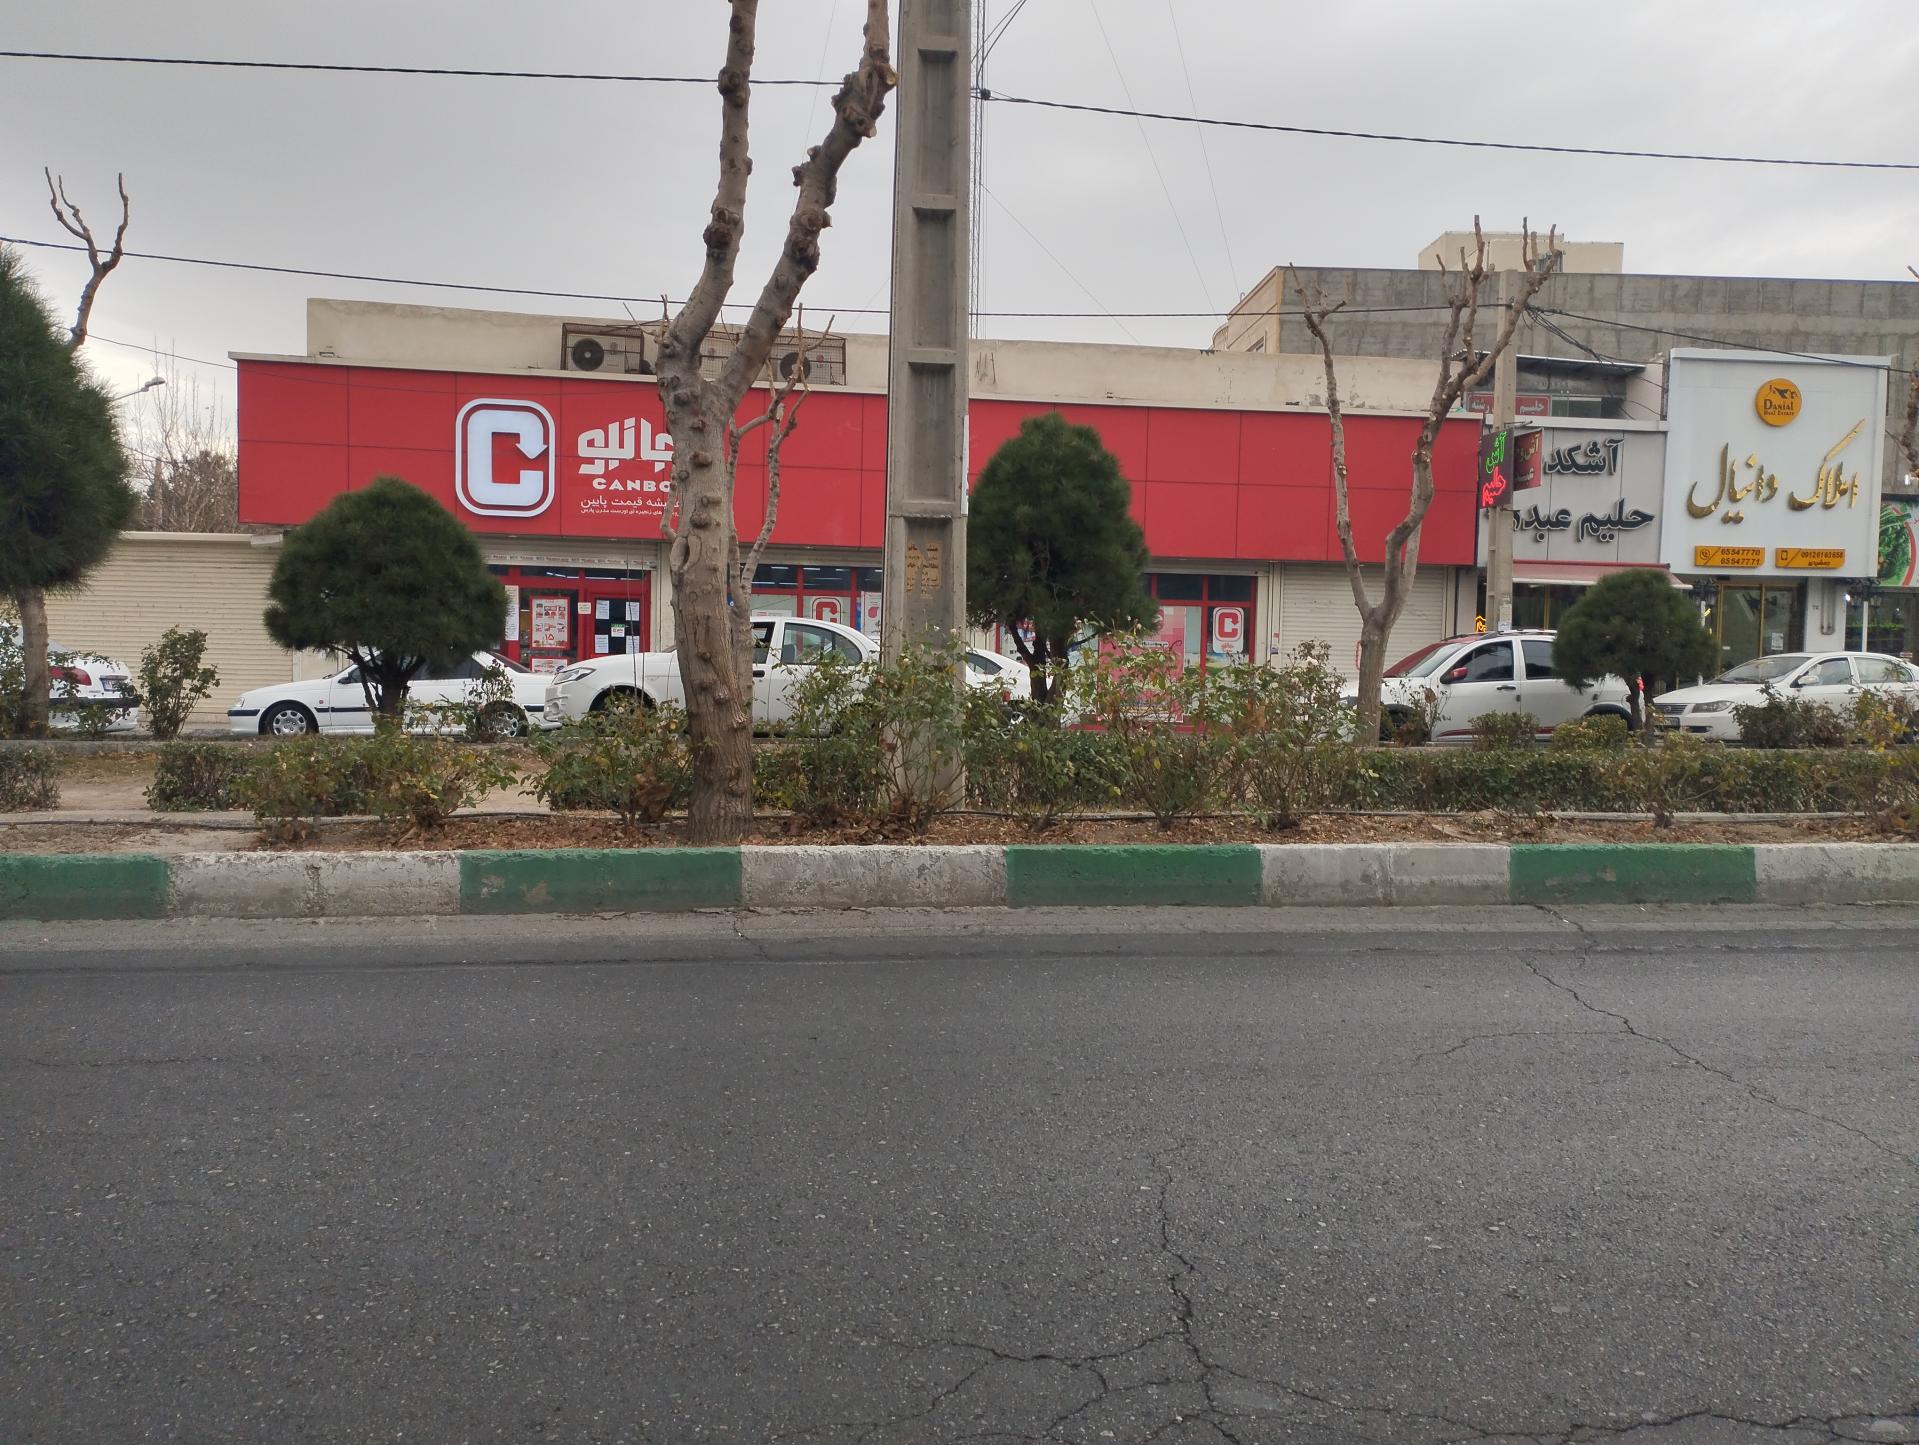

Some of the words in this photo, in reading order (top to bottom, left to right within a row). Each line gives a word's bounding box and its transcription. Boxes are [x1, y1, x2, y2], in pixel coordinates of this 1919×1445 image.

[1686, 442, 1779, 524] دانیال
[580, 495, 608, 508] پایین
[611, 496, 643, 508] قیمت
[1577, 498, 1655, 542] حلیم
